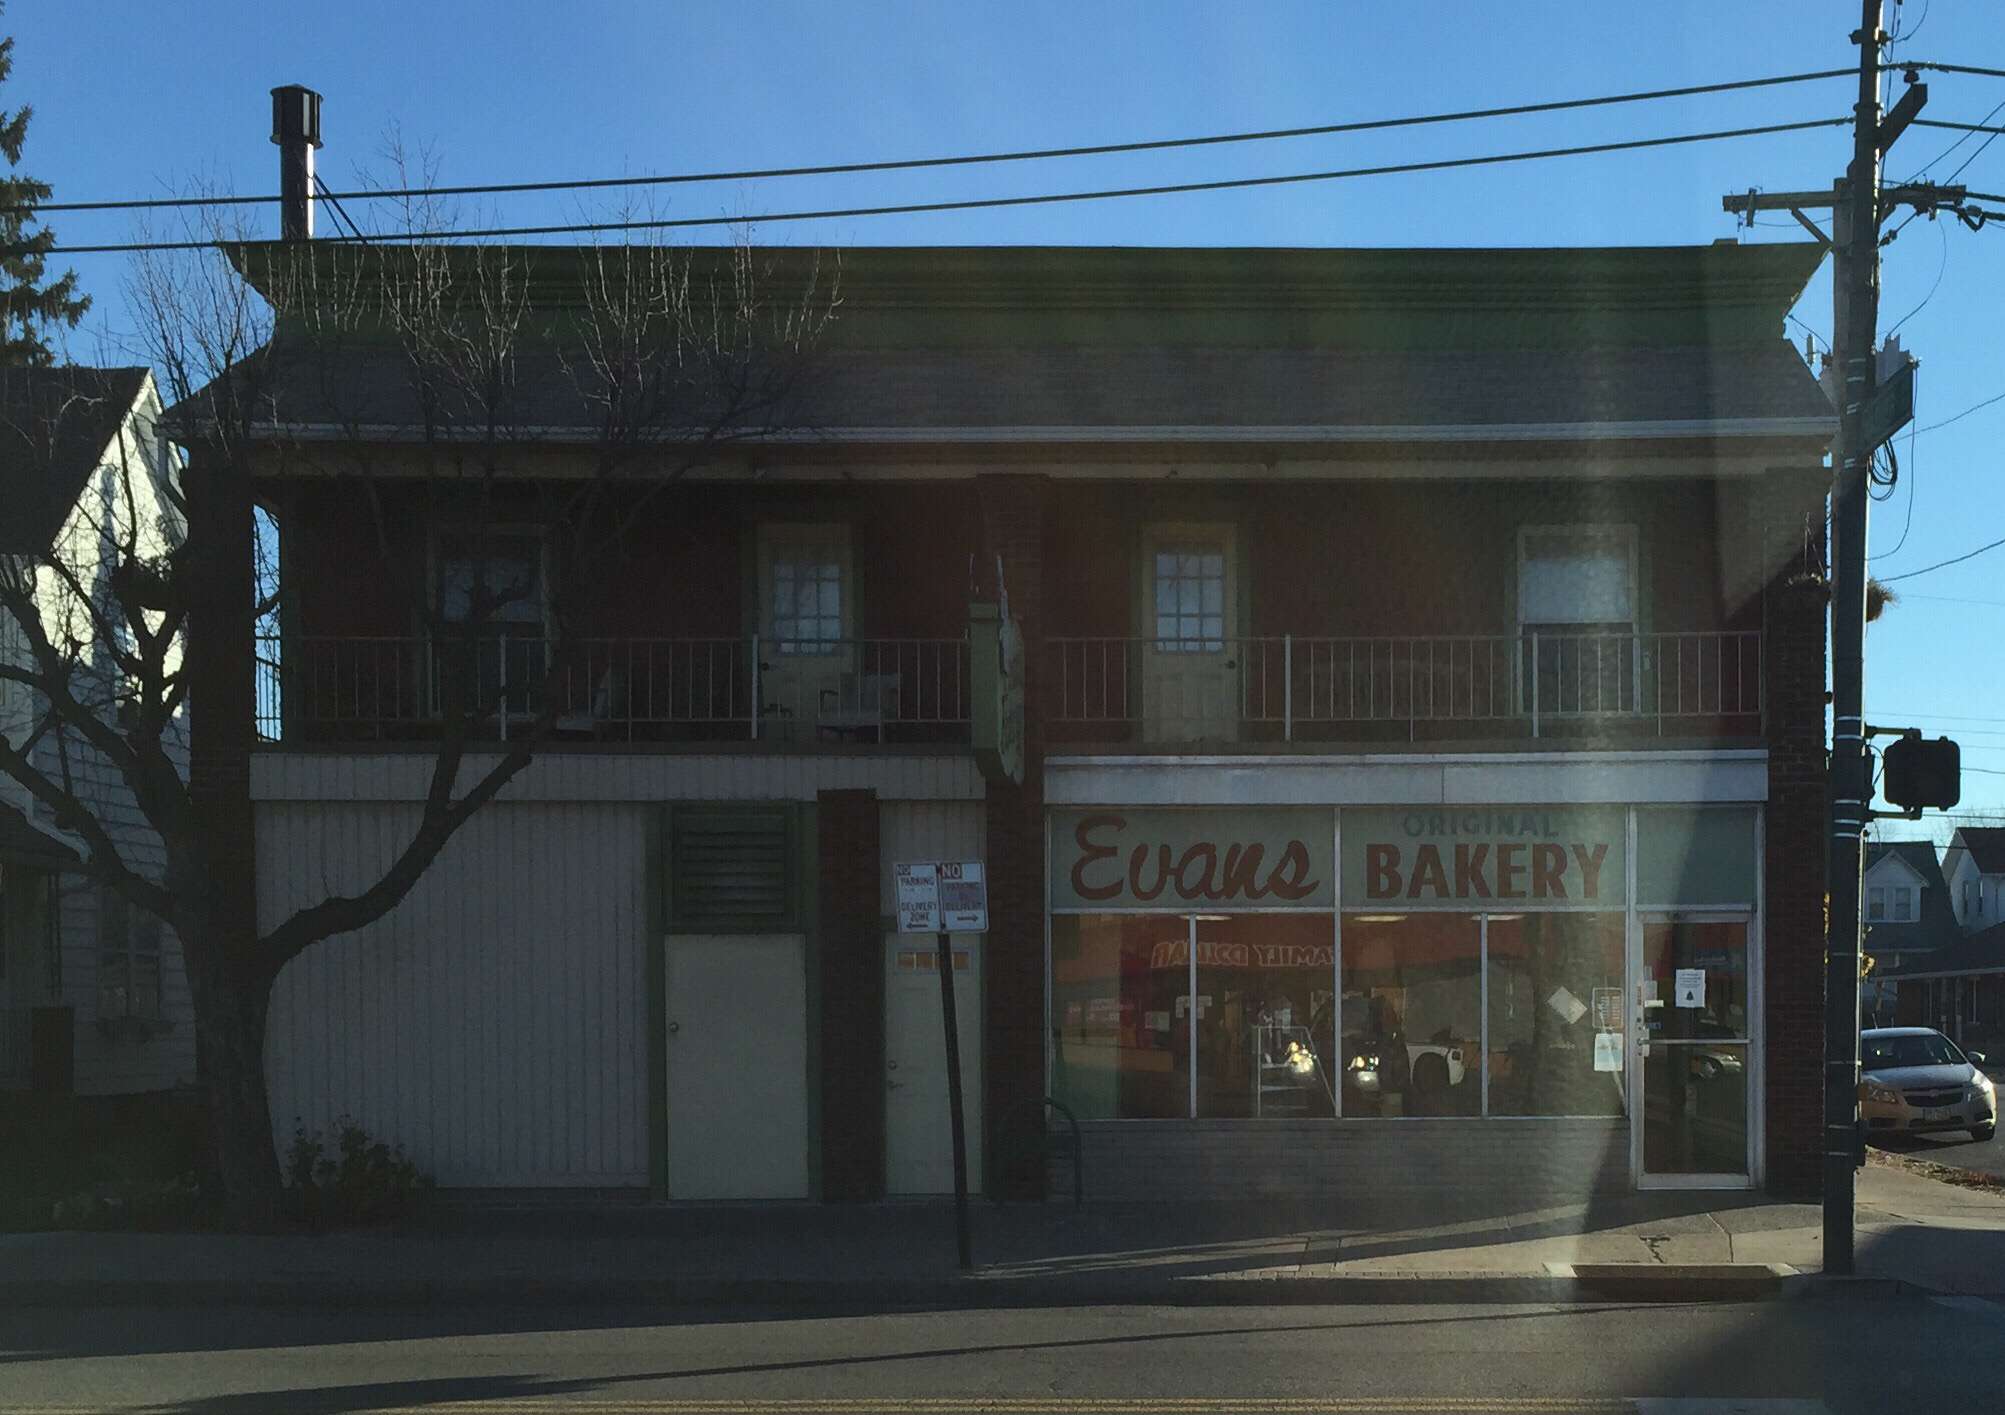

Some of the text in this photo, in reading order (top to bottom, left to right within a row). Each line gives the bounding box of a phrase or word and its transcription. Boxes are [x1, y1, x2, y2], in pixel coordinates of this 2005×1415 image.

[1403, 813, 1559, 838] ORIGINAL
[942, 863, 960, 878] NO
[1071, 815, 1320, 900] Evans
[1366, 843, 1608, 899] BAKERY
